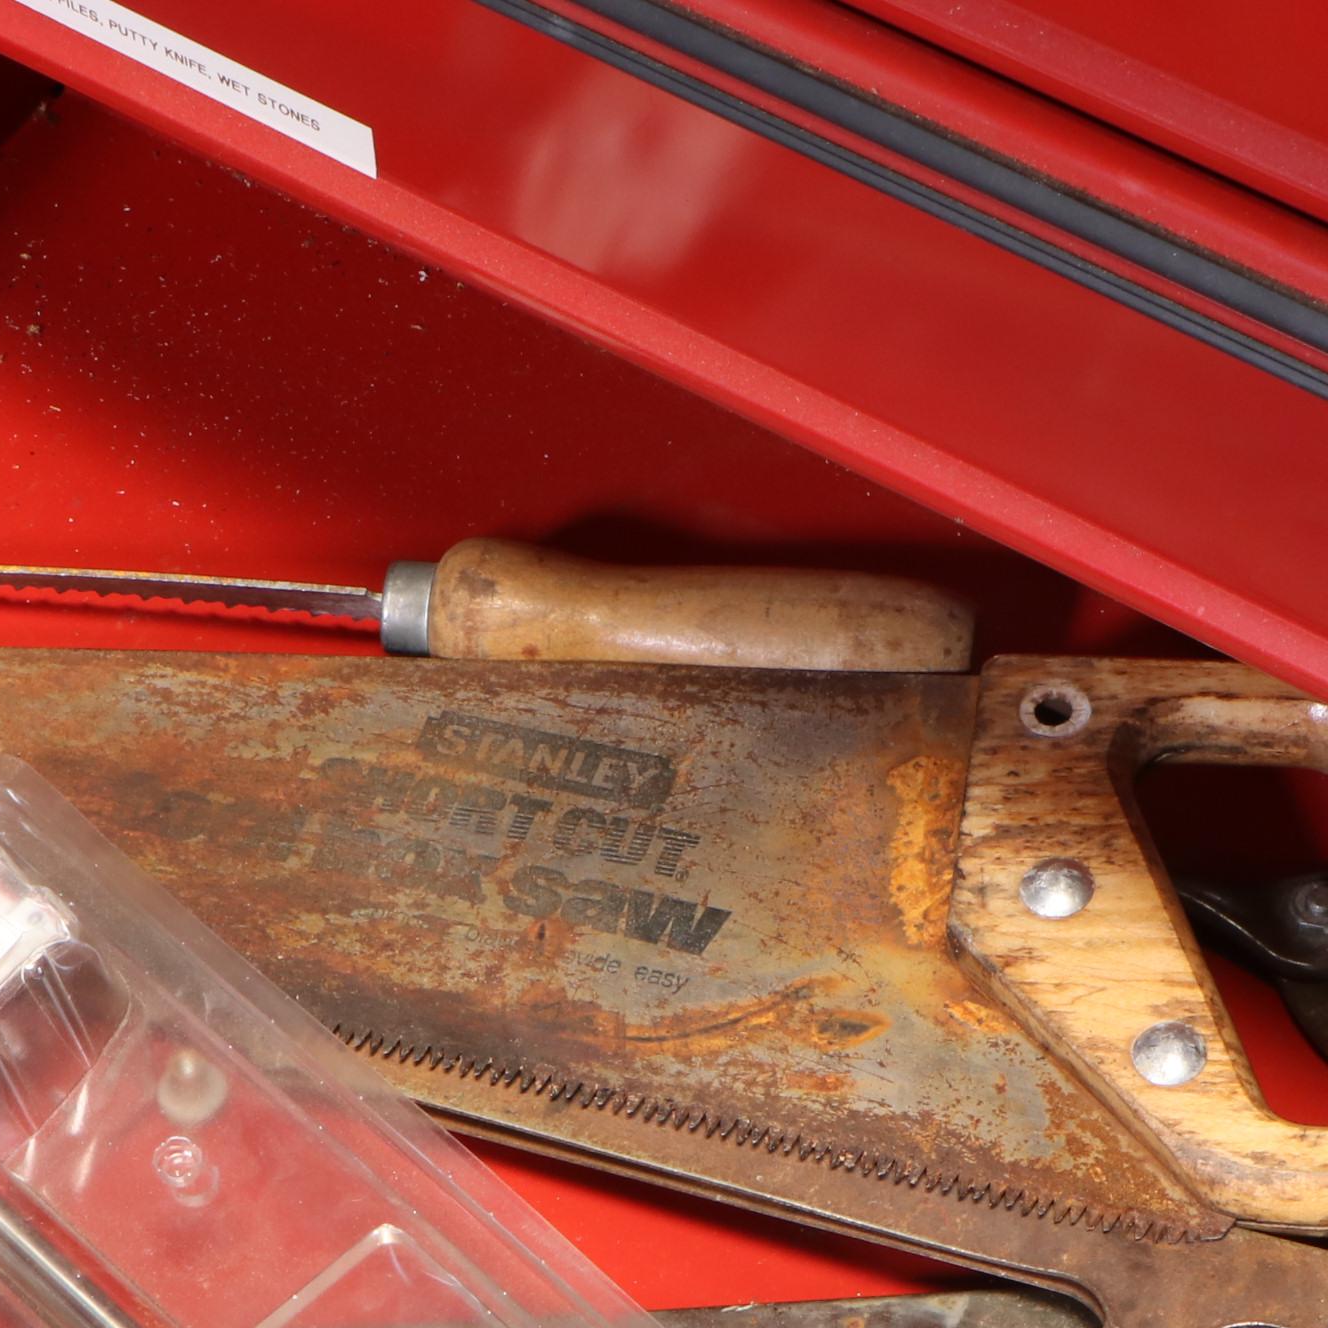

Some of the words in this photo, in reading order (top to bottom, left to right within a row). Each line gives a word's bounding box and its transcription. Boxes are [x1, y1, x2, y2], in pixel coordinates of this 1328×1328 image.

[109, 19, 159, 51] PUTTY
[164, 46, 213, 80] KNIFE,
[217, 72, 251, 98] WET
[257, 92, 321, 132] STONES
[434, 720, 662, 792] STANLEY
[553, 806, 702, 878] CUT
[632, 963, 691, 995] easy
